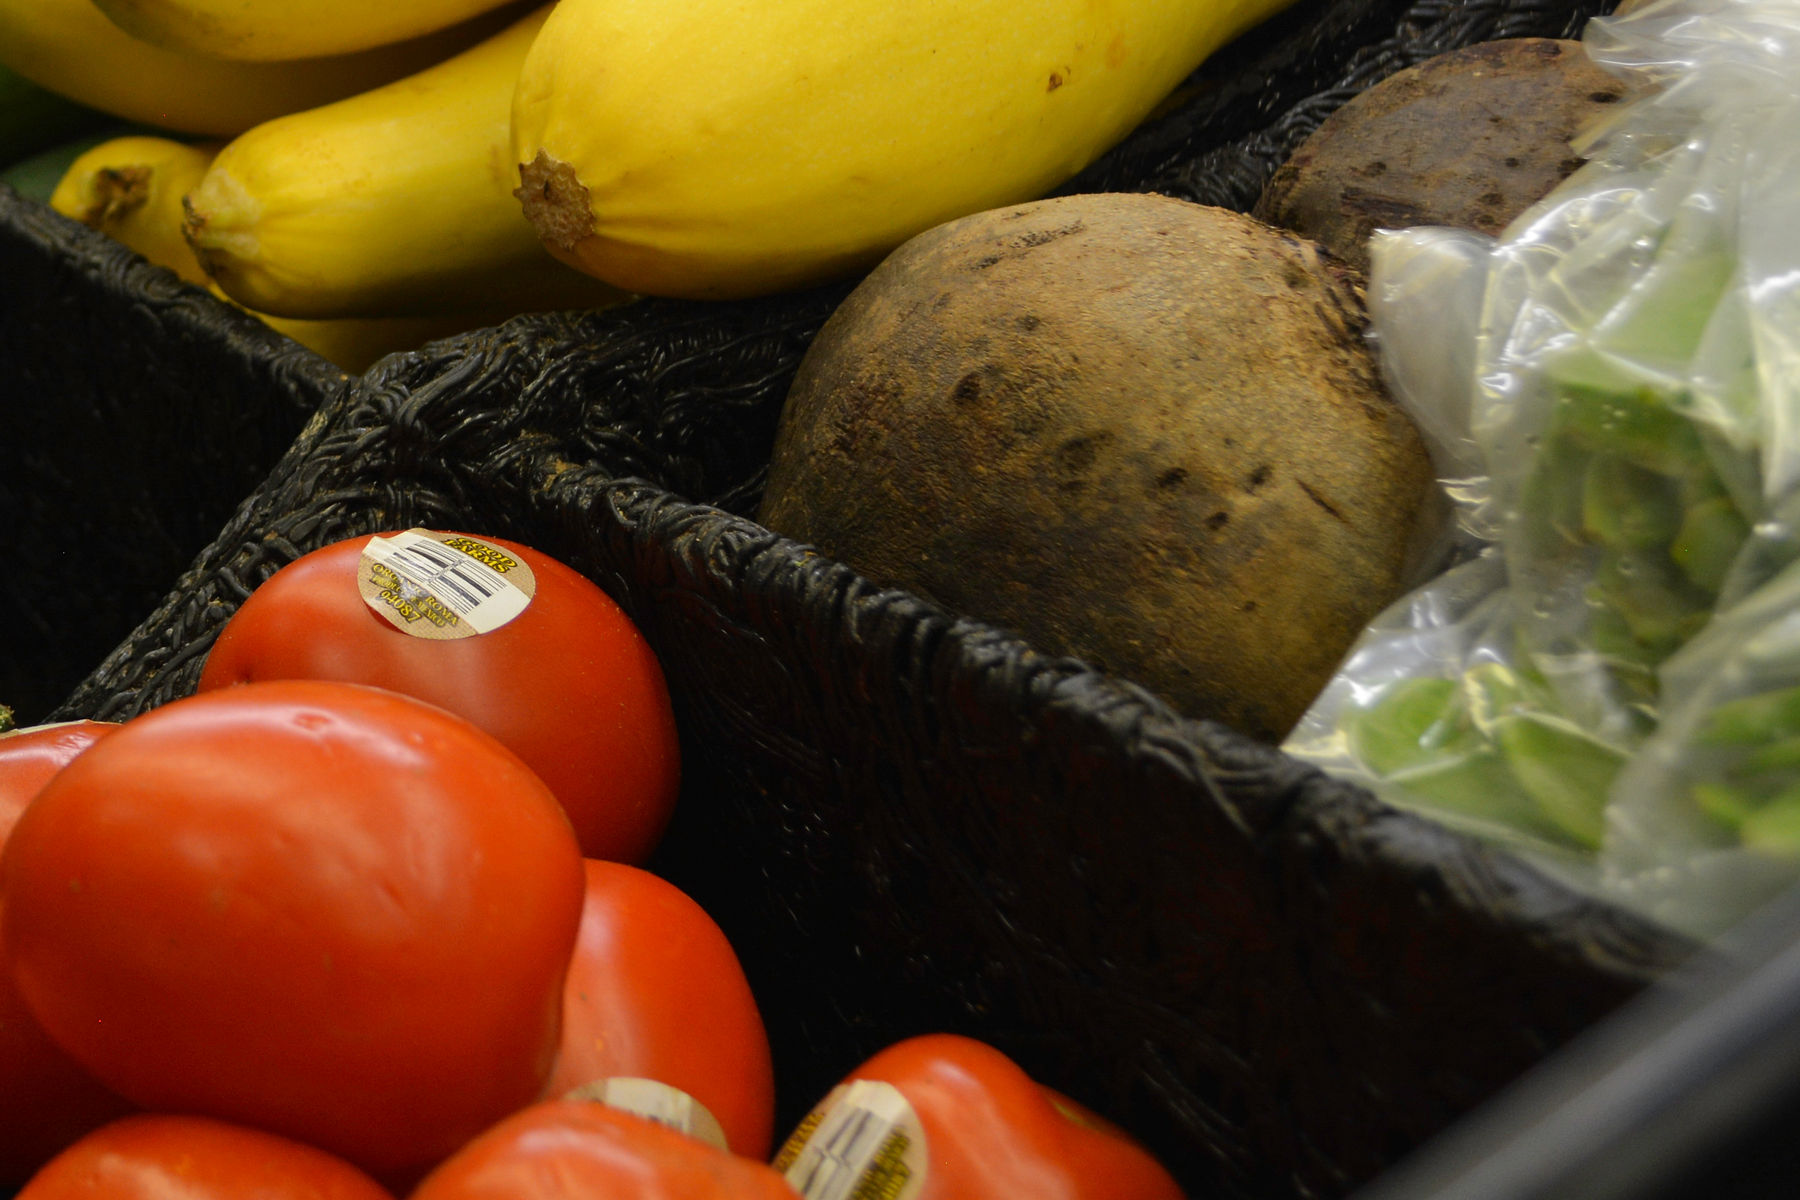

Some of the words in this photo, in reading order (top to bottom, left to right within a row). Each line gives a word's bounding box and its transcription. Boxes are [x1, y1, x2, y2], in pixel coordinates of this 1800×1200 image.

[443, 539, 511, 574] FARMS
[455, 537, 517, 567] GOOD
[380, 590, 422, 623] 94087
[425, 596, 460, 628] ROMA
